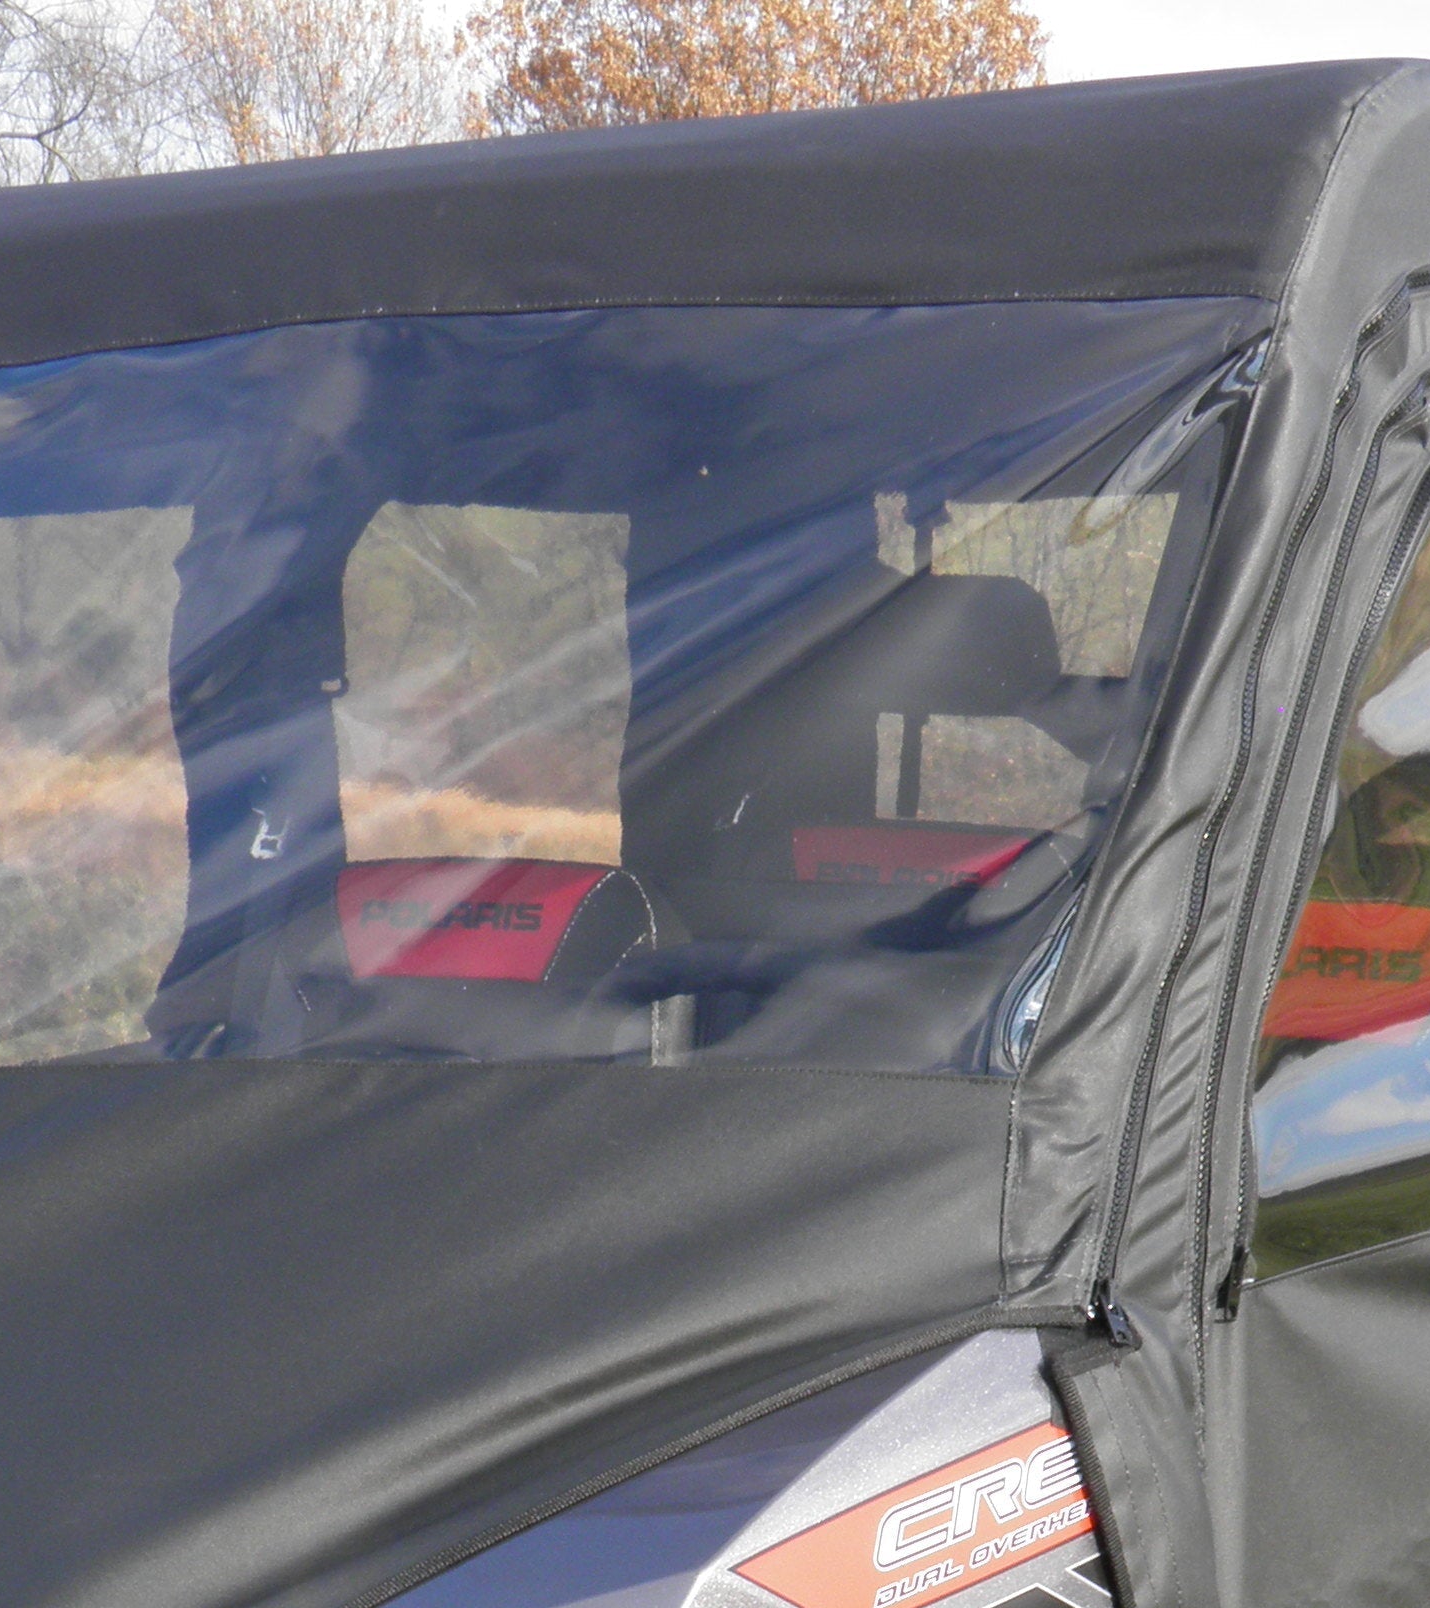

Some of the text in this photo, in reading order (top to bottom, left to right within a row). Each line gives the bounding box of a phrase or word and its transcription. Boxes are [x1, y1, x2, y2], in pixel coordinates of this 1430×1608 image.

[360, 901, 543, 931] POLARIS
[1281, 946, 1423, 983] ARIS
[873, 1436, 1083, 1573] CRE
